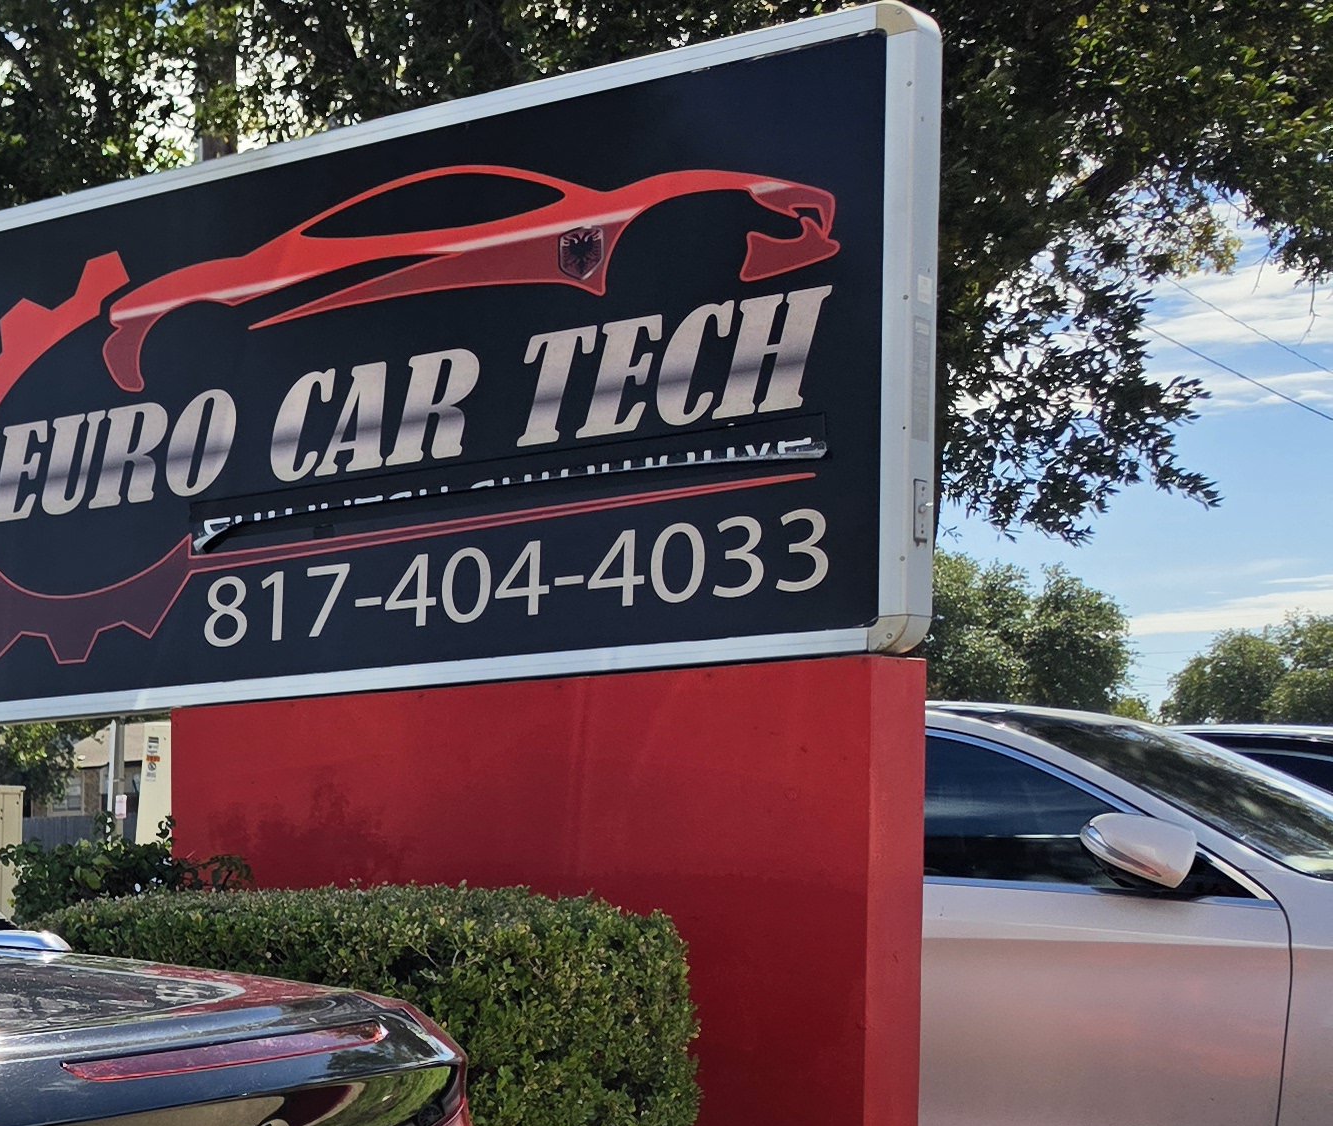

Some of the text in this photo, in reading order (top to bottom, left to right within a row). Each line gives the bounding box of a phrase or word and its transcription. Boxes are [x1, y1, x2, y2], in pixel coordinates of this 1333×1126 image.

[269, 347, 481, 482] CAR
[516, 284, 833, 447] TECH
[203, 507, 829, 648] 817-404-4033
